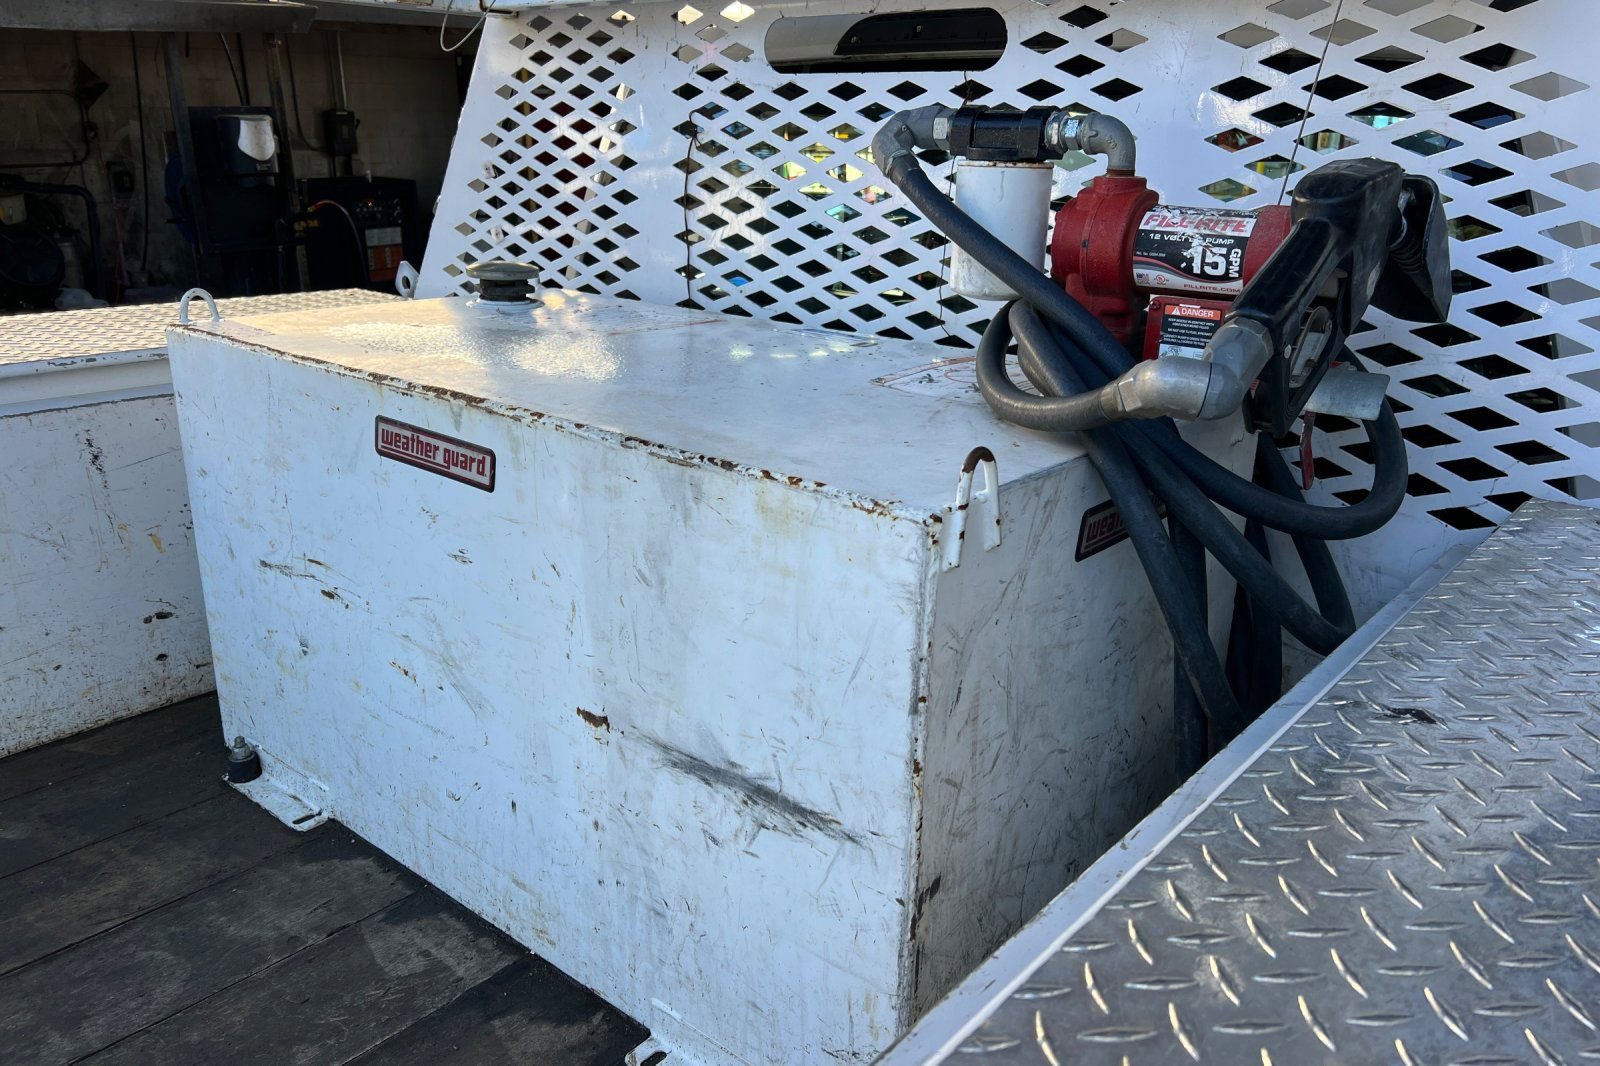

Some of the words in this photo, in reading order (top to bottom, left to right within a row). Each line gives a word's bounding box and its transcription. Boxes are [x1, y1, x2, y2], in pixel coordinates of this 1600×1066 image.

[1143, 214, 1247, 232] FILL-RITE
[1164, 234, 1189, 242] VOLT
[1205, 237, 1234, 245] PUMP
[1192, 246, 1227, 276] 15
[1228, 248, 1241, 278] GPM
[1183, 283, 1241, 293] FILLRITE.COM
[1181, 307, 1214, 318] DANGER
[381, 428, 440, 460] weather
[443, 447, 486, 477] guard
